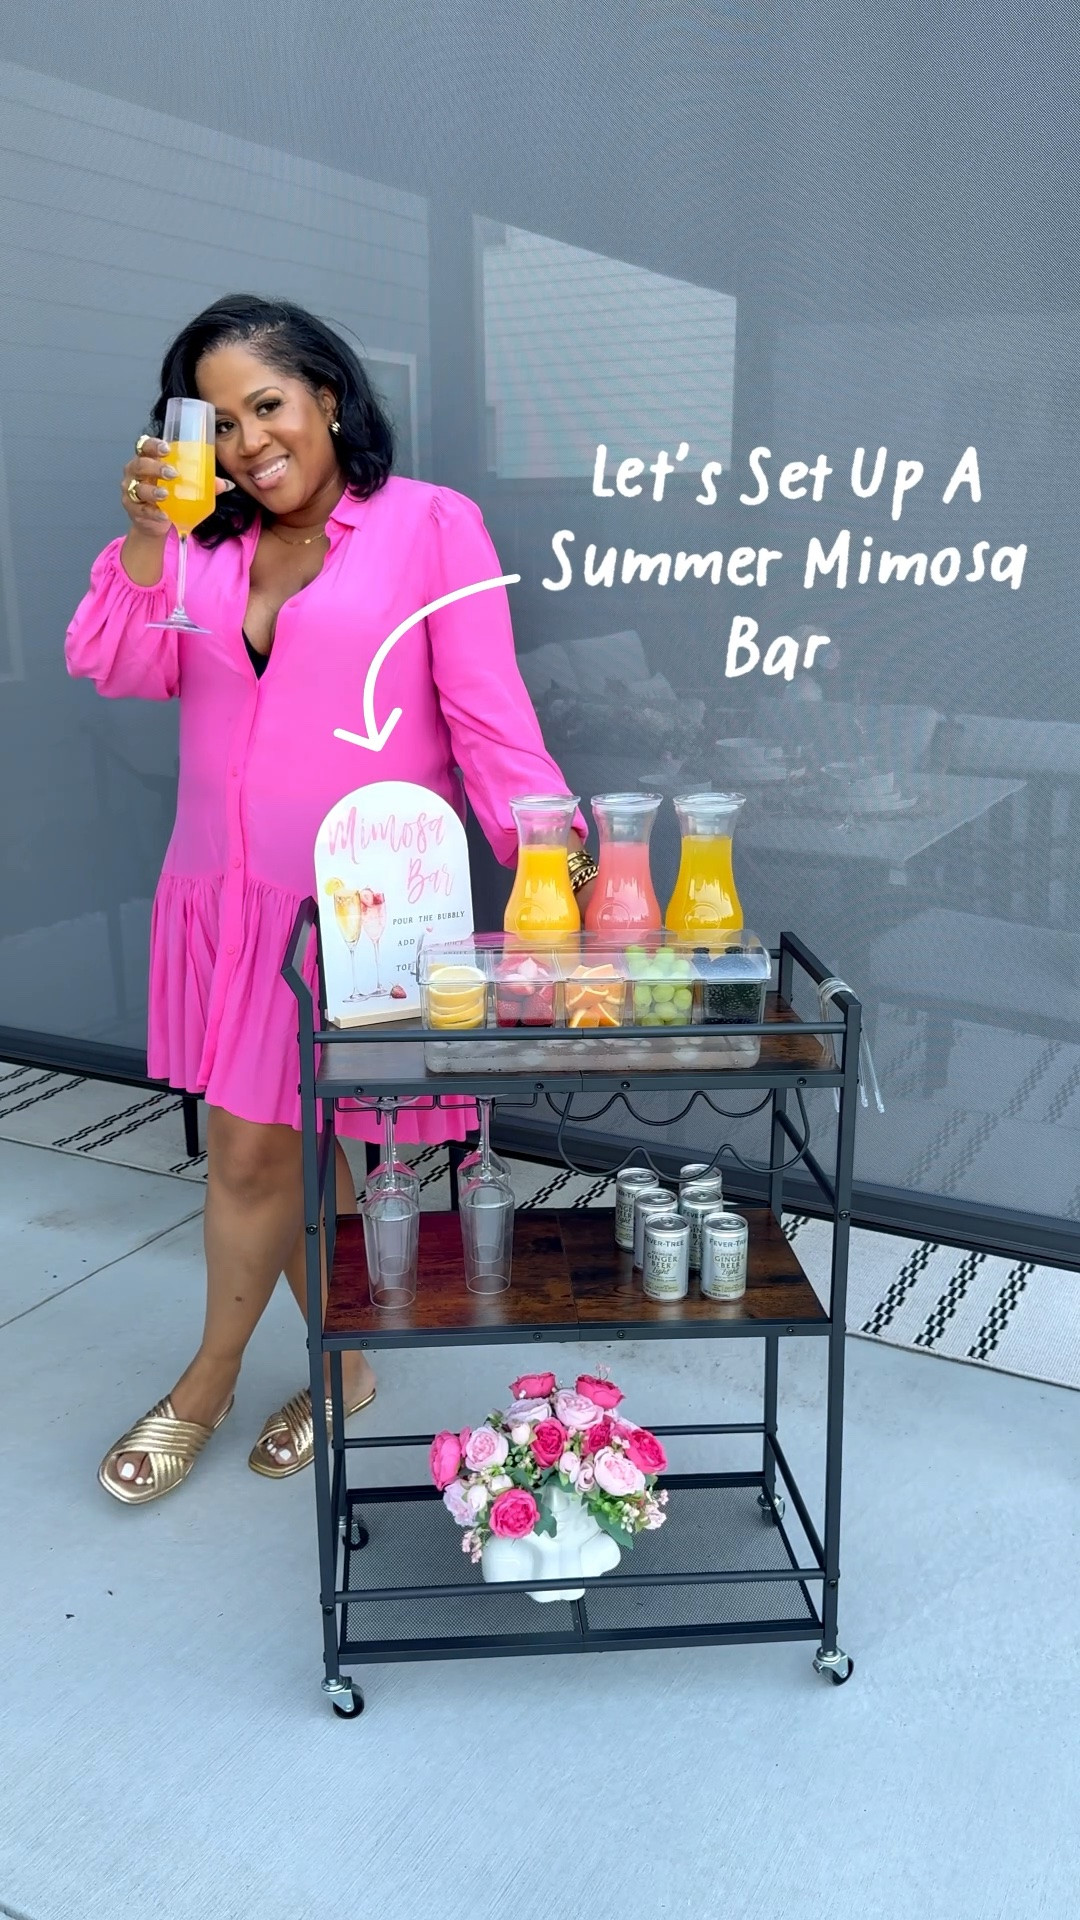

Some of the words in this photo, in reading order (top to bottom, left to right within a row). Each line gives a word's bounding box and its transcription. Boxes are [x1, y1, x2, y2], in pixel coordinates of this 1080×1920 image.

[328, 806, 446, 865] Mimosa
[407, 857, 456, 905] Bar
[392, 916, 414, 926] POUR
[418, 914, 434, 923] THE
[437, 910, 466, 920] BUBBLY
[397, 938, 416, 947] ADD
[646, 1252, 678, 1263] GINGER
[651, 1260, 672, 1269] BEER
[720, 1261, 741, 1269] BEER
